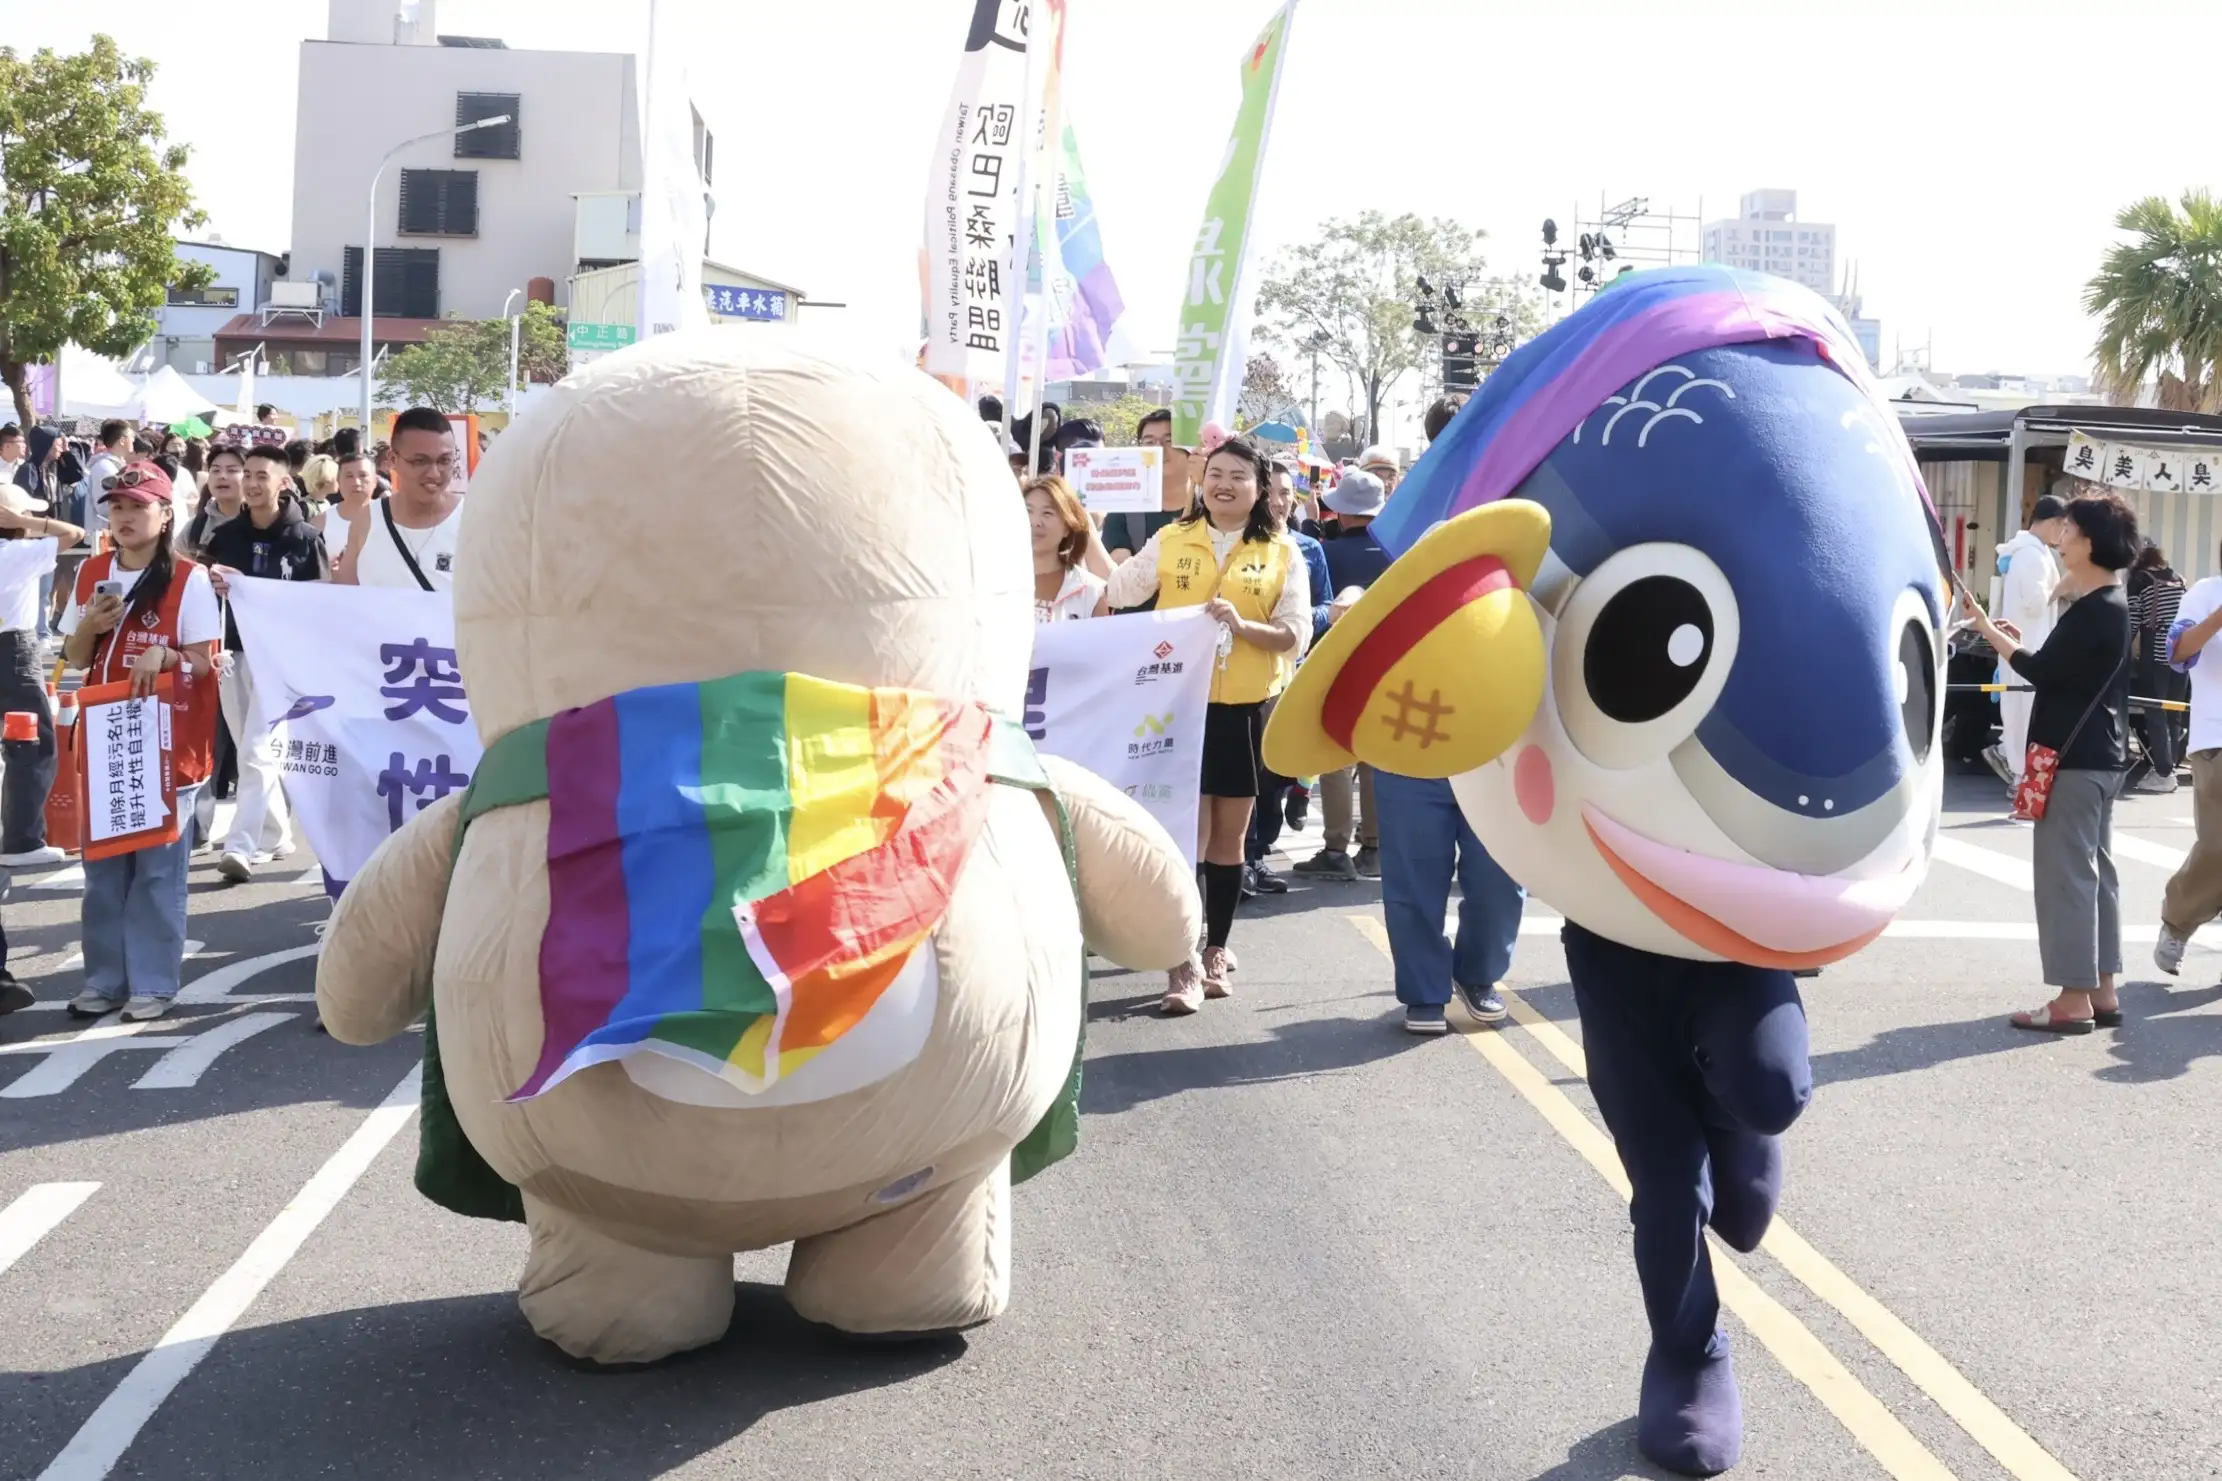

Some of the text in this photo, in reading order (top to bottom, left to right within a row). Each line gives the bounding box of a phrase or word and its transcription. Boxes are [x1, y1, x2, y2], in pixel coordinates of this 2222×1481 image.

[576, 324, 628, 340] 中正路
[380, 637, 468, 724] 突
[270, 738, 338, 764] 台灣前進
[106, 704, 126, 833] 消除月經污名化
[308, 763, 321, 775] GO
[324, 765, 338, 777] GO
